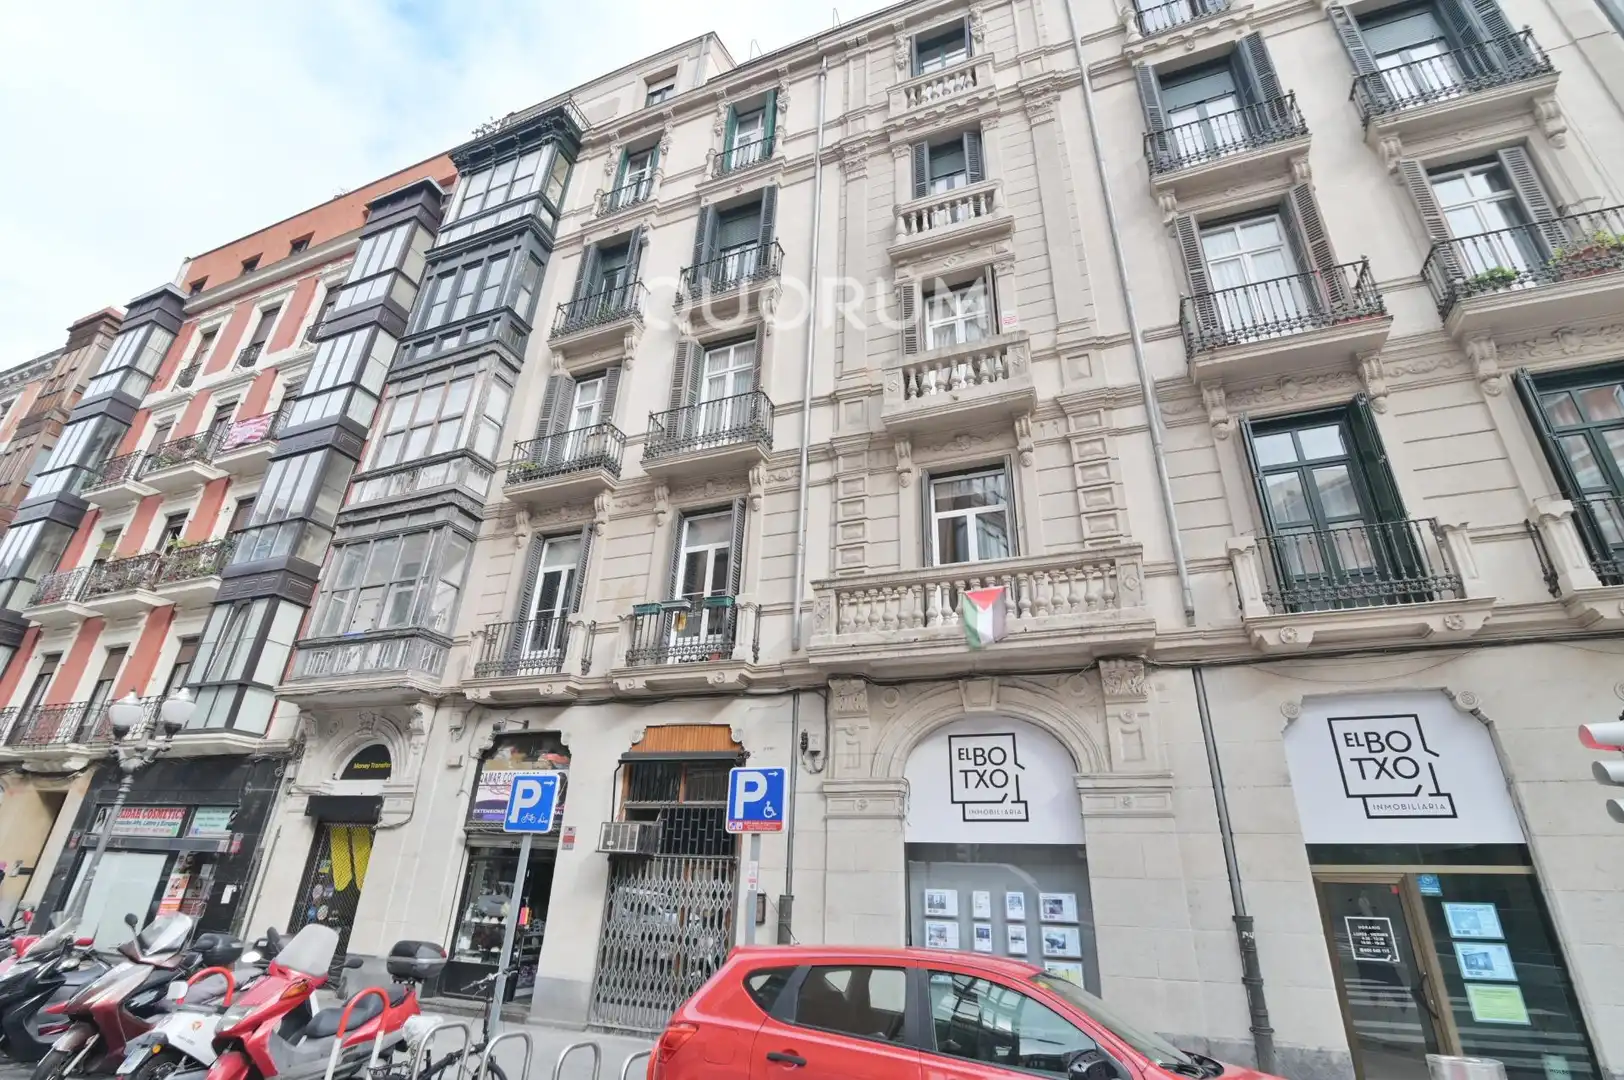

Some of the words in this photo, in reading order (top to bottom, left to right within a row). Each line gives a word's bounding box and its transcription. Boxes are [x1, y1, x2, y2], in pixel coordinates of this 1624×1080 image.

[959, 768, 1008, 789] TXO
[1350, 756, 1420, 780] TXO
[510, 779, 542, 823] P
[734, 771, 768, 819] P
[142, 807, 186, 820] COSMETICS
[969, 808, 1022, 816] INMOBILIARIA
[1372, 803, 1447, 811] INMOBILIARIA
